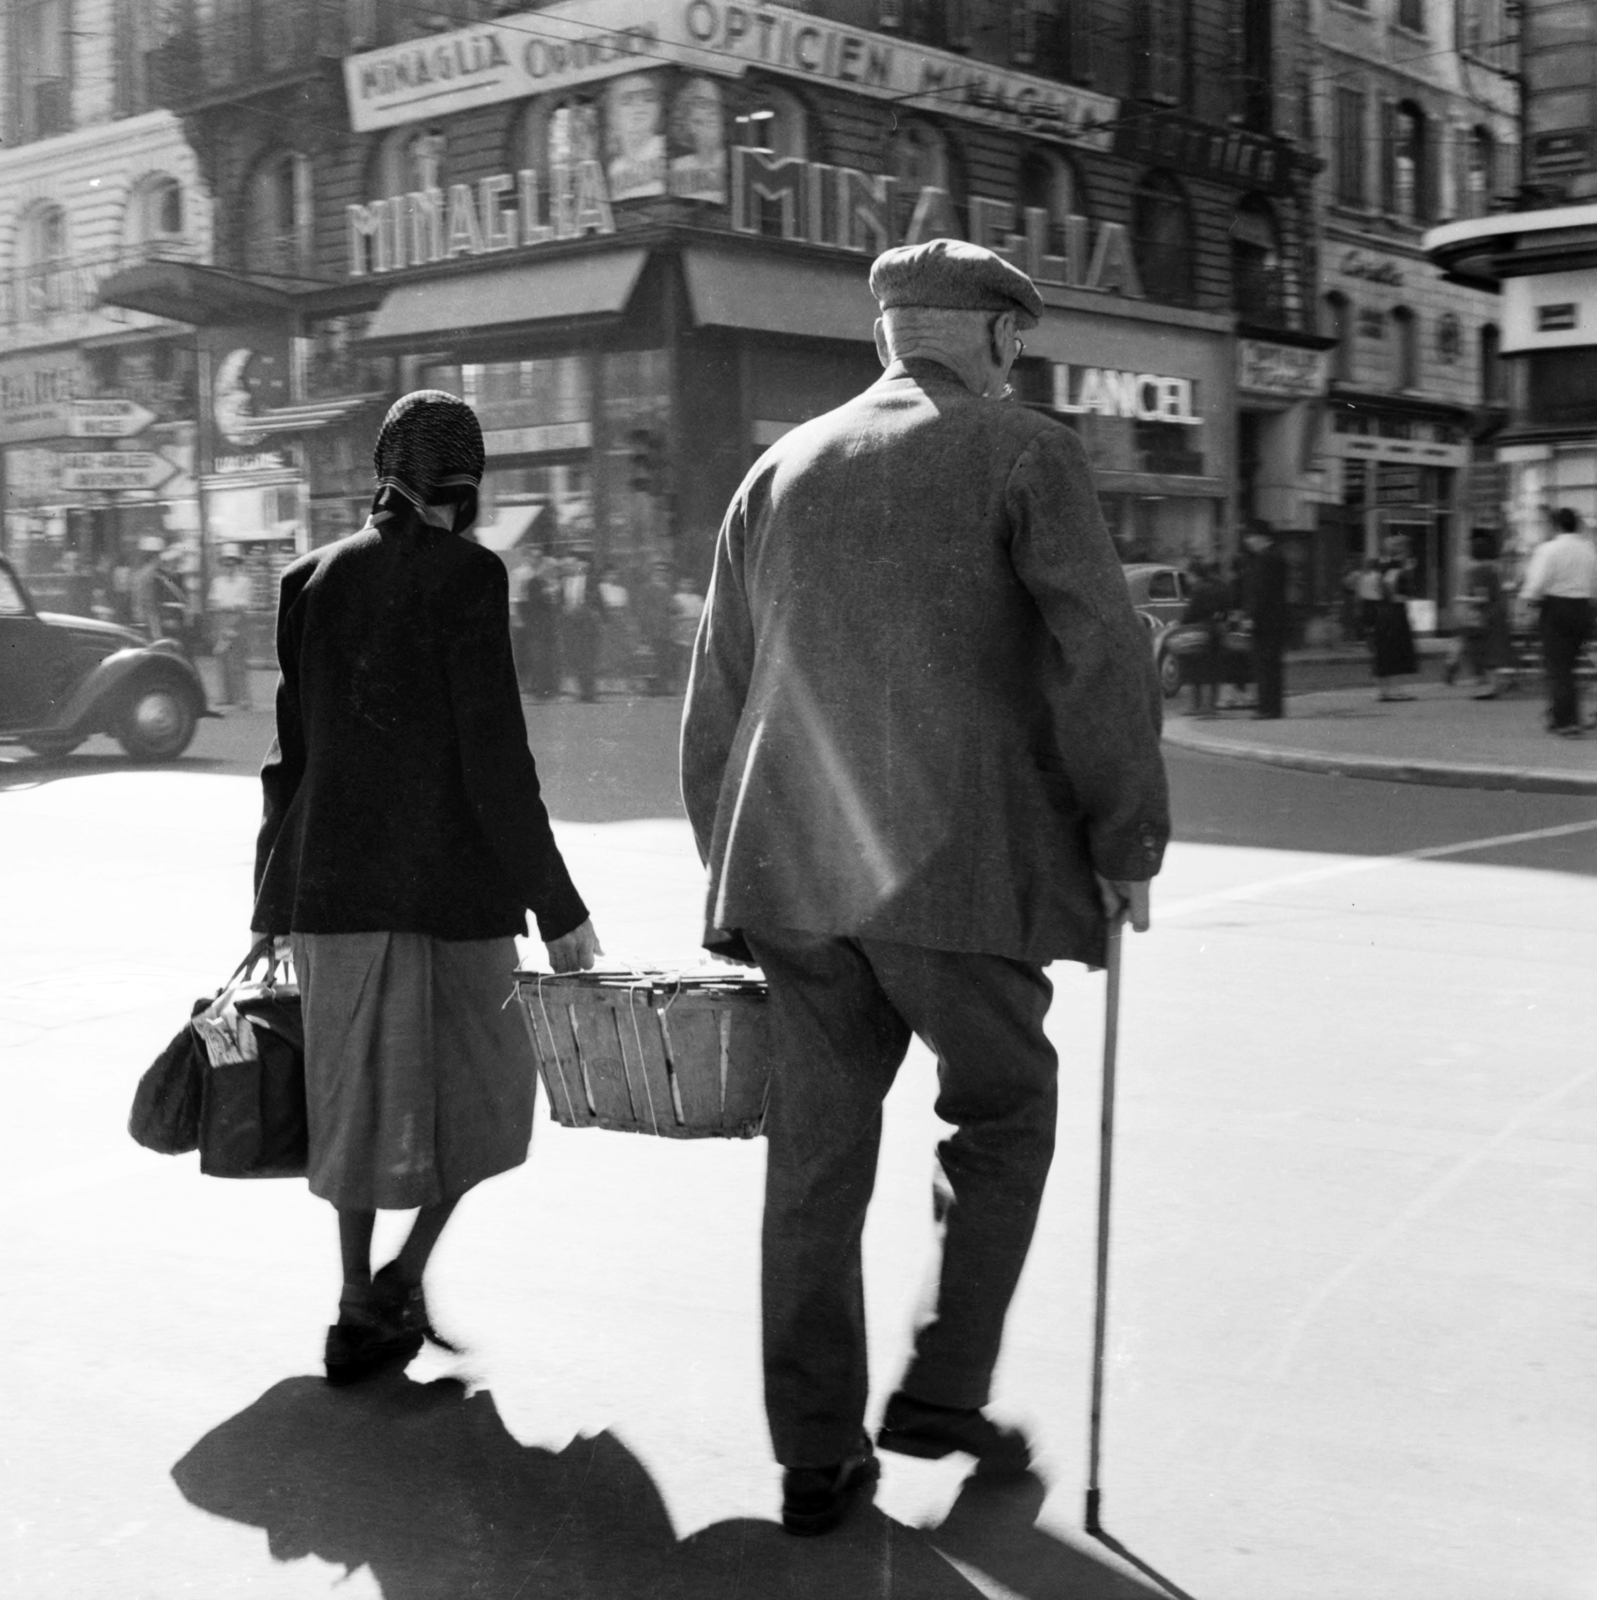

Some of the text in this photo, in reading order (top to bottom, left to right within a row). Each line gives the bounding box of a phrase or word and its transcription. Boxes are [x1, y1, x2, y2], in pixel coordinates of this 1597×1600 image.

[684, 0, 896, 87] OPTICIEN
[346, 159, 616, 276] MINAGLIA
[731, 144, 1144, 298] MINAGLIA
[1053, 362, 1205, 425] LANCEL
